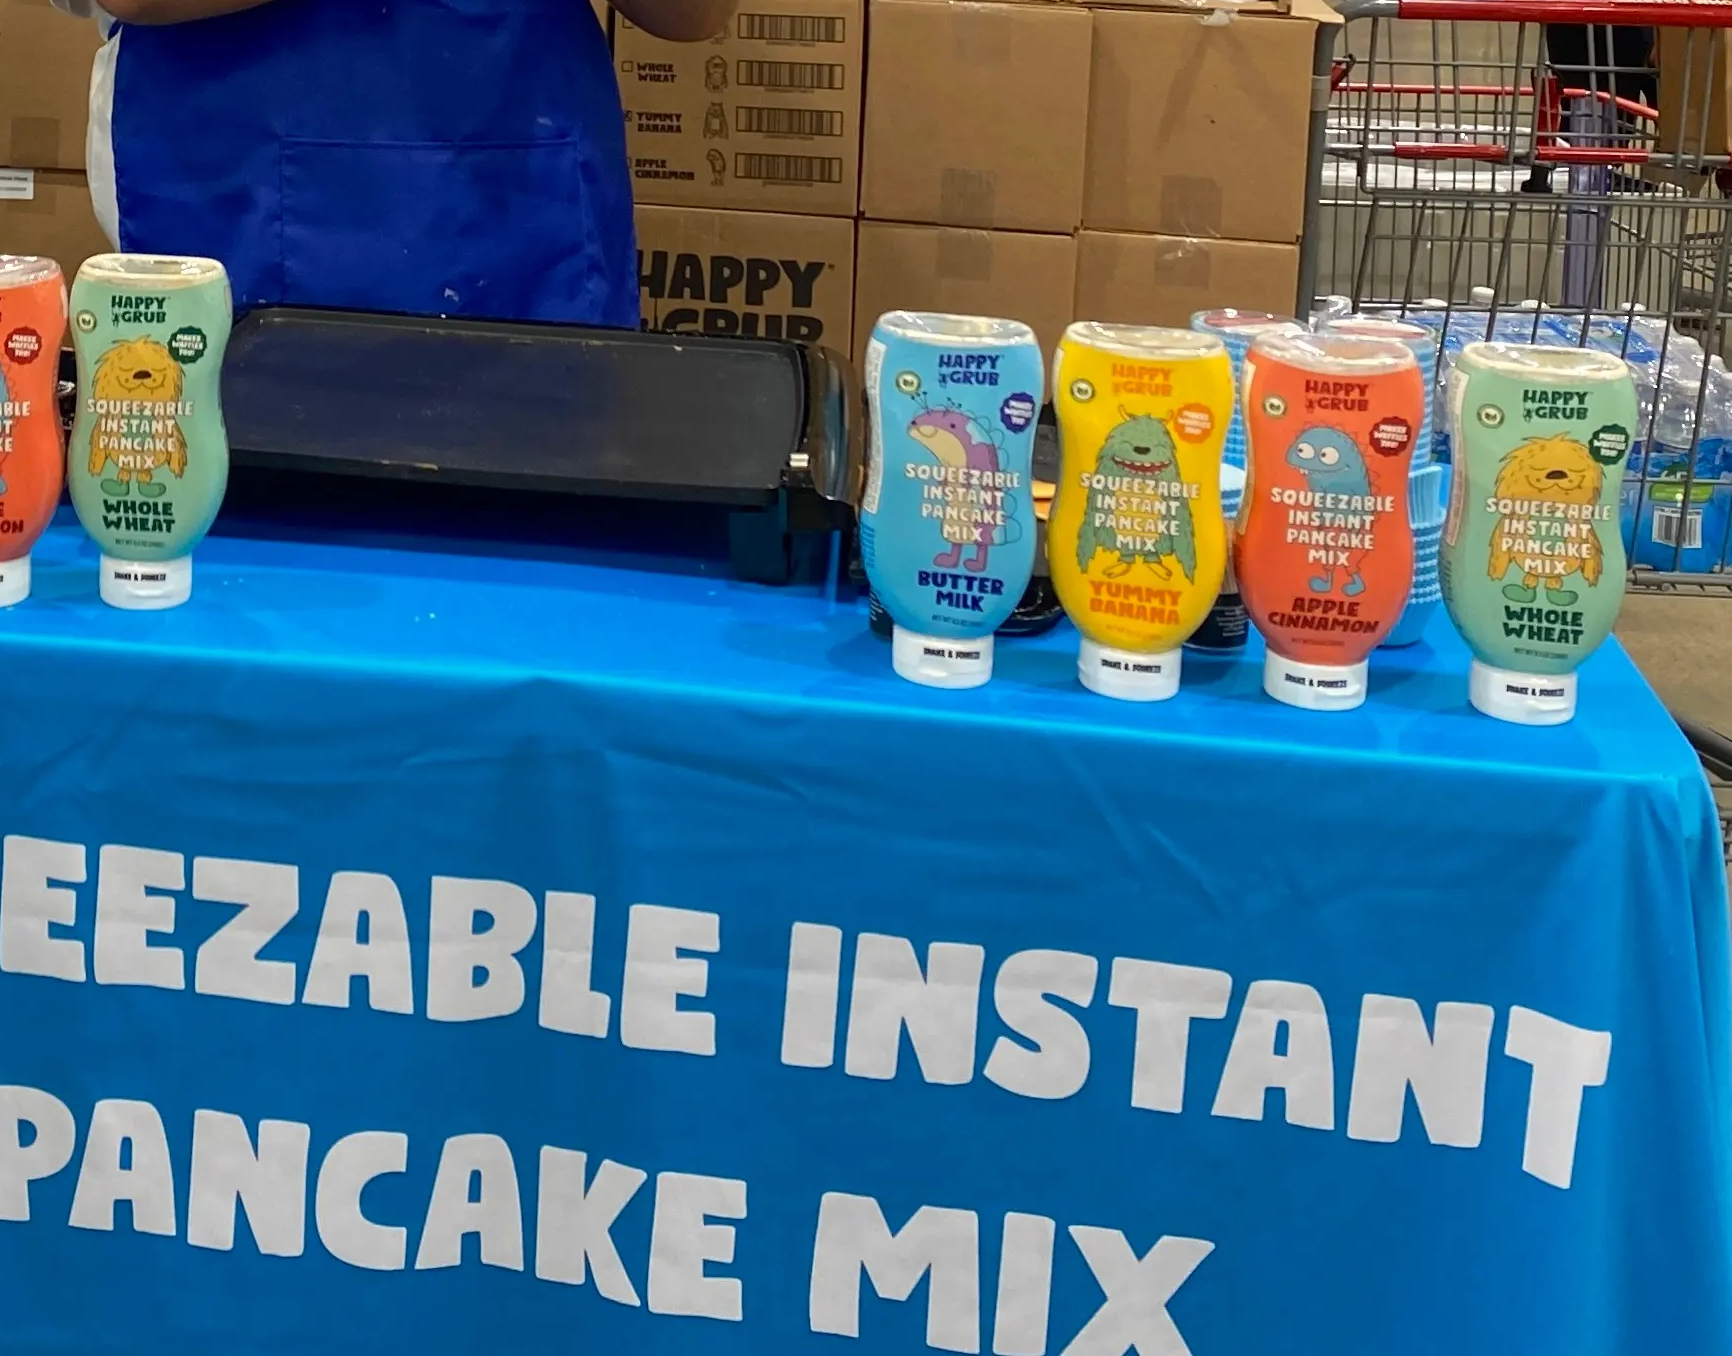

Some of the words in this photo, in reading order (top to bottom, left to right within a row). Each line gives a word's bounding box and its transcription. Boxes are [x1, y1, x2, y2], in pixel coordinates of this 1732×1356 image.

[637, 62, 674, 72] WHOLE
[638, 74, 677, 83] WHEAT
[637, 112, 682, 123] YUMMY
[637, 123, 682, 133] BANANA
[635, 159, 667, 168] APPLE
[635, 170, 695, 180] CINNAMON
[637, 250, 825, 308] HAPPY
[111, 296, 166, 310] HAPPY
[123, 310, 167, 323] GRUB
[939, 354, 1000, 370] HAPPY
[950, 371, 999, 386] GRUB
[1112, 364, 1171, 382] HAPPY
[1123, 381, 1172, 397] GRUB
[1305, 380, 1369, 397] HAPPY
[1523, 390, 1588, 405] HAPPY
[87, 398, 194, 417] SQUEEZABLE
[1317, 397, 1369, 412] GRUB
[1535, 406, 1588, 420] GRUB
[101, 418, 176, 435] INSTANT
[99, 435, 176, 453] PANCAKE
[118, 453, 155, 469] MIX
[904, 464, 1020, 488] SQUEEZABLE
[1080, 473, 1200, 499] SQUEEZABLE
[923, 485, 1005, 506] INSTANT
[1271, 487, 1395, 513] SQUEEZABLE
[103, 499, 173, 516] WHOLE
[1097, 495, 1180, 516] INSTANT
[1486, 498, 1613, 521] SQUEEZABLE
[103, 516, 176, 533] WHEAT
[921, 505, 1006, 526] PANCAKE
[1094, 513, 1180, 536] PANCAKE
[1288, 511, 1375, 531] INSTANT
[943, 524, 982, 542] MIX
[1503, 519, 1592, 539] INSTANT
[1116, 535, 1155, 553] MIX
[1286, 529, 1374, 550] PANCAKE
[1501, 538, 1592, 559] PANCAKE
[1308, 550, 1350, 567] MIX
[1524, 558, 1568, 576] MIX
[918, 570, 1004, 595] BUTTER
[936, 589, 984, 613] MILK
[1089, 581, 1182, 607] YUMMY
[1090, 597, 1180, 625] BANANA
[1291, 596, 1361, 618] APPLE
[1504, 605, 1584, 626] WHOLE
[1268, 612, 1379, 634] CINNAMON
[1502, 622, 1584, 645] WHEAT
[782, 920, 1614, 1189] INSTANT
[807, 1189, 1217, 1356] MIX
